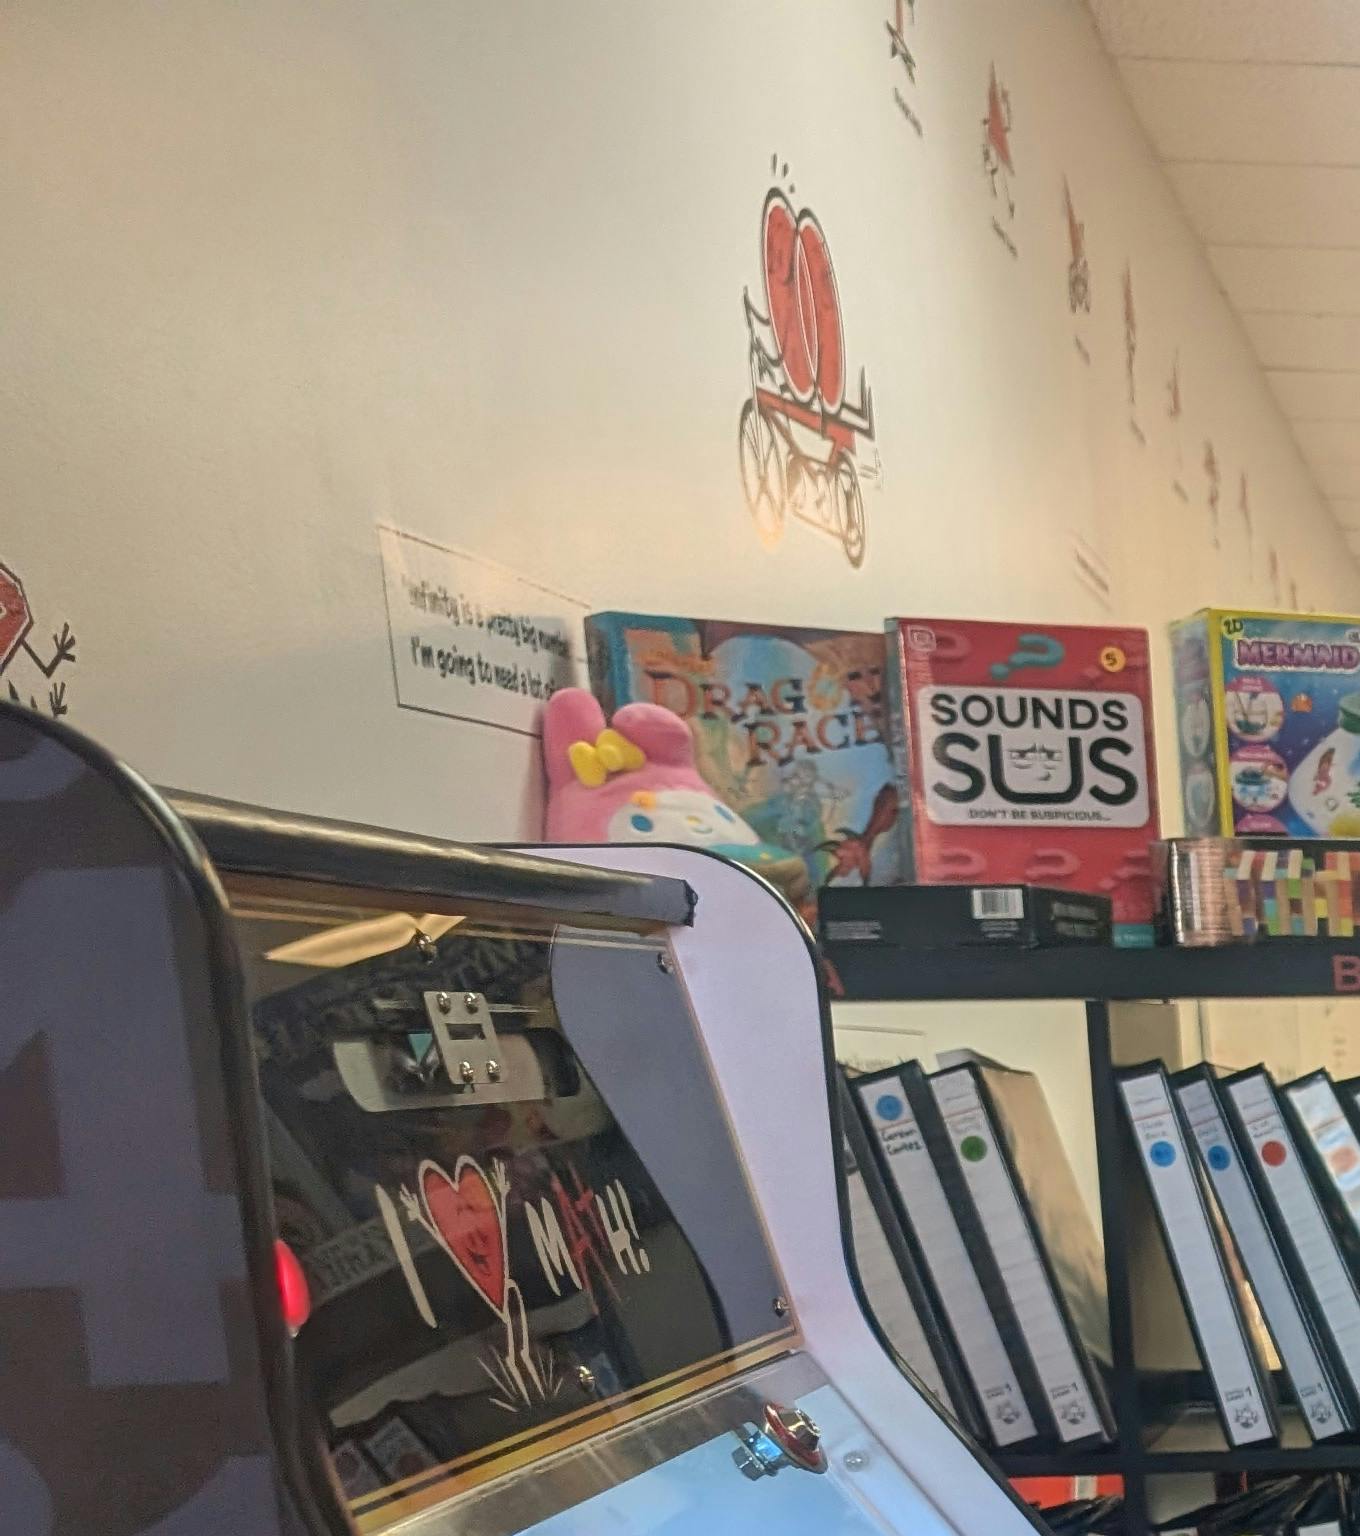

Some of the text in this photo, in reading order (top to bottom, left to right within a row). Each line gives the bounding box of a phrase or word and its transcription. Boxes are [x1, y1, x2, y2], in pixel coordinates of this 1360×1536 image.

[436, 644, 476, 686] going
[930, 692, 1129, 732] SOUNDS
[744, 711, 886, 768] RACE
[931, 731, 1139, 806] SUS
[967, 809, 1008, 821] DON'T
[1011, 810, 1027, 821] BE
[524, 1160, 652, 1318] MATH!
